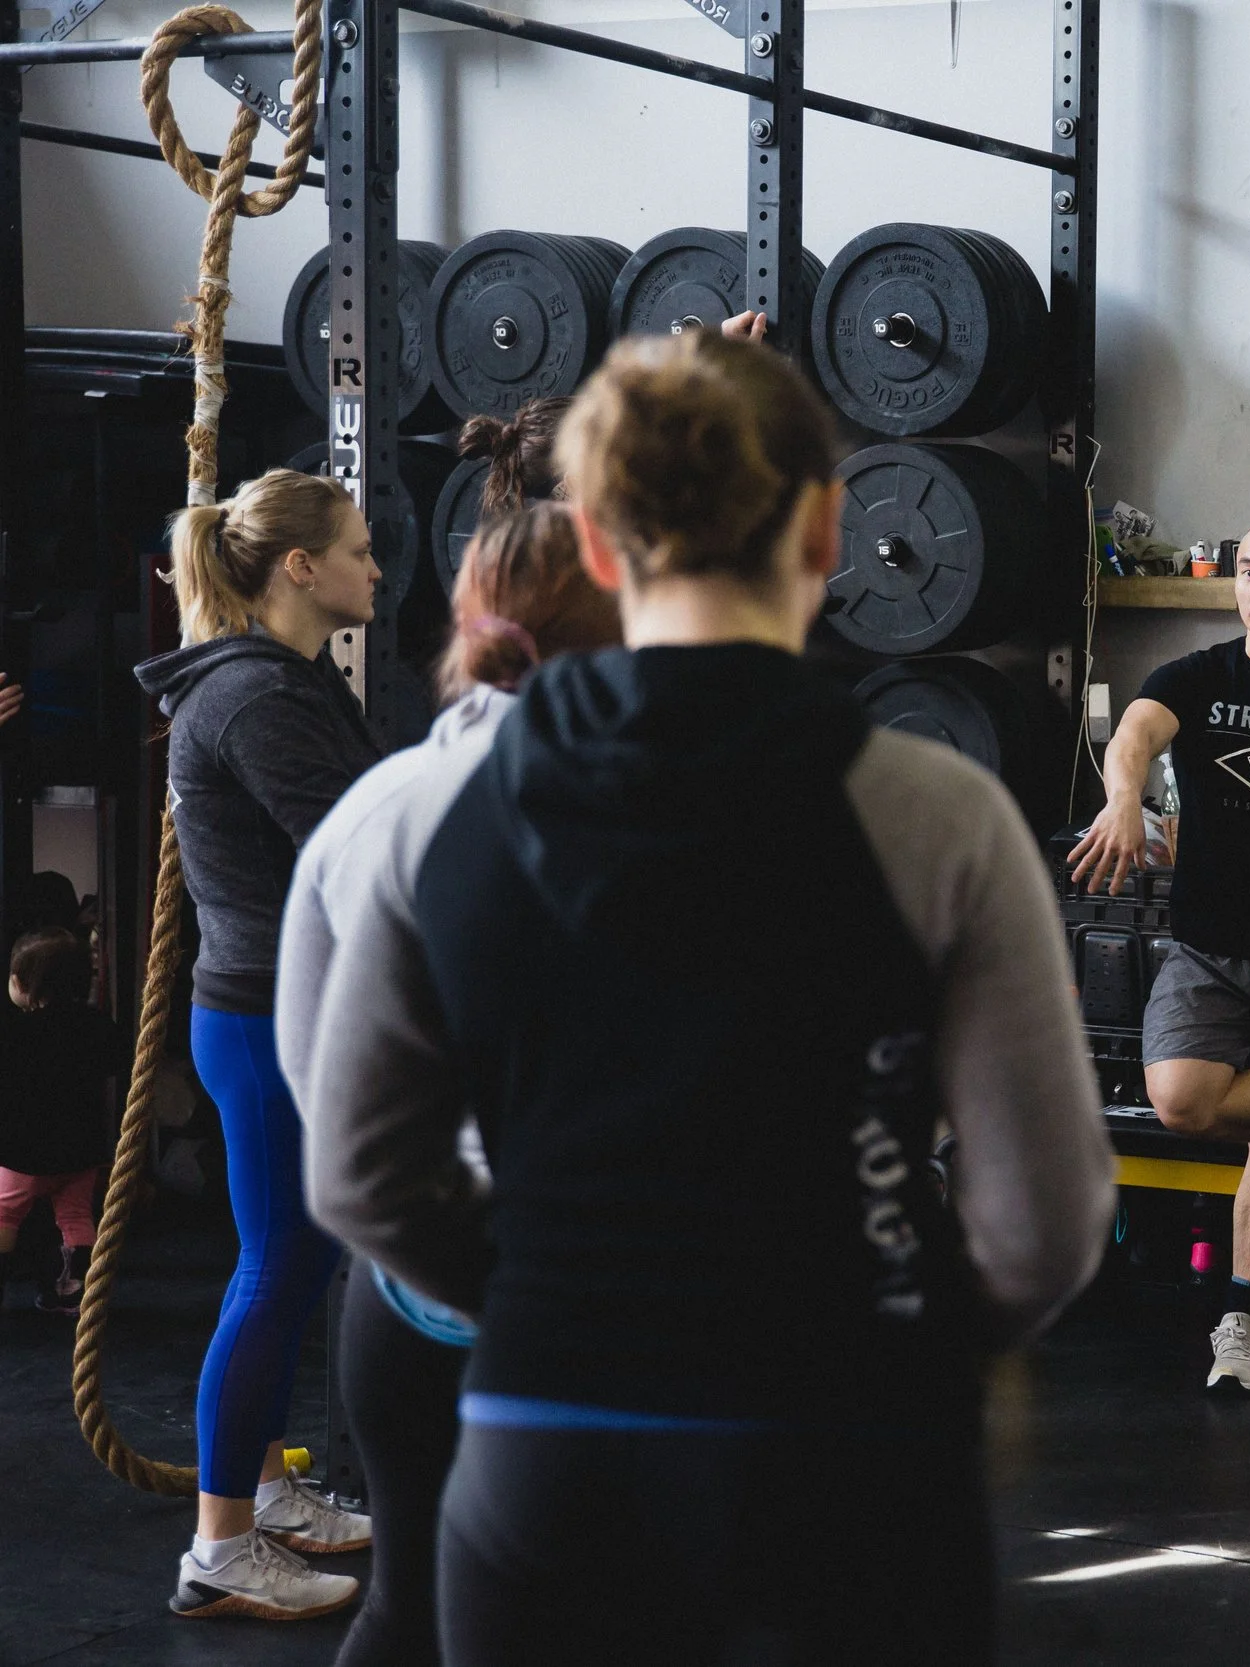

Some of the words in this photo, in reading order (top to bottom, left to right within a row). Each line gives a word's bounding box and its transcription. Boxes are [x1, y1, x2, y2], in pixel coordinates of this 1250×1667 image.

[495, 328, 506, 337] 10
[671, 326, 682, 335] 10
[874, 323, 886, 334] 10
[877, 545, 890, 555] 15
